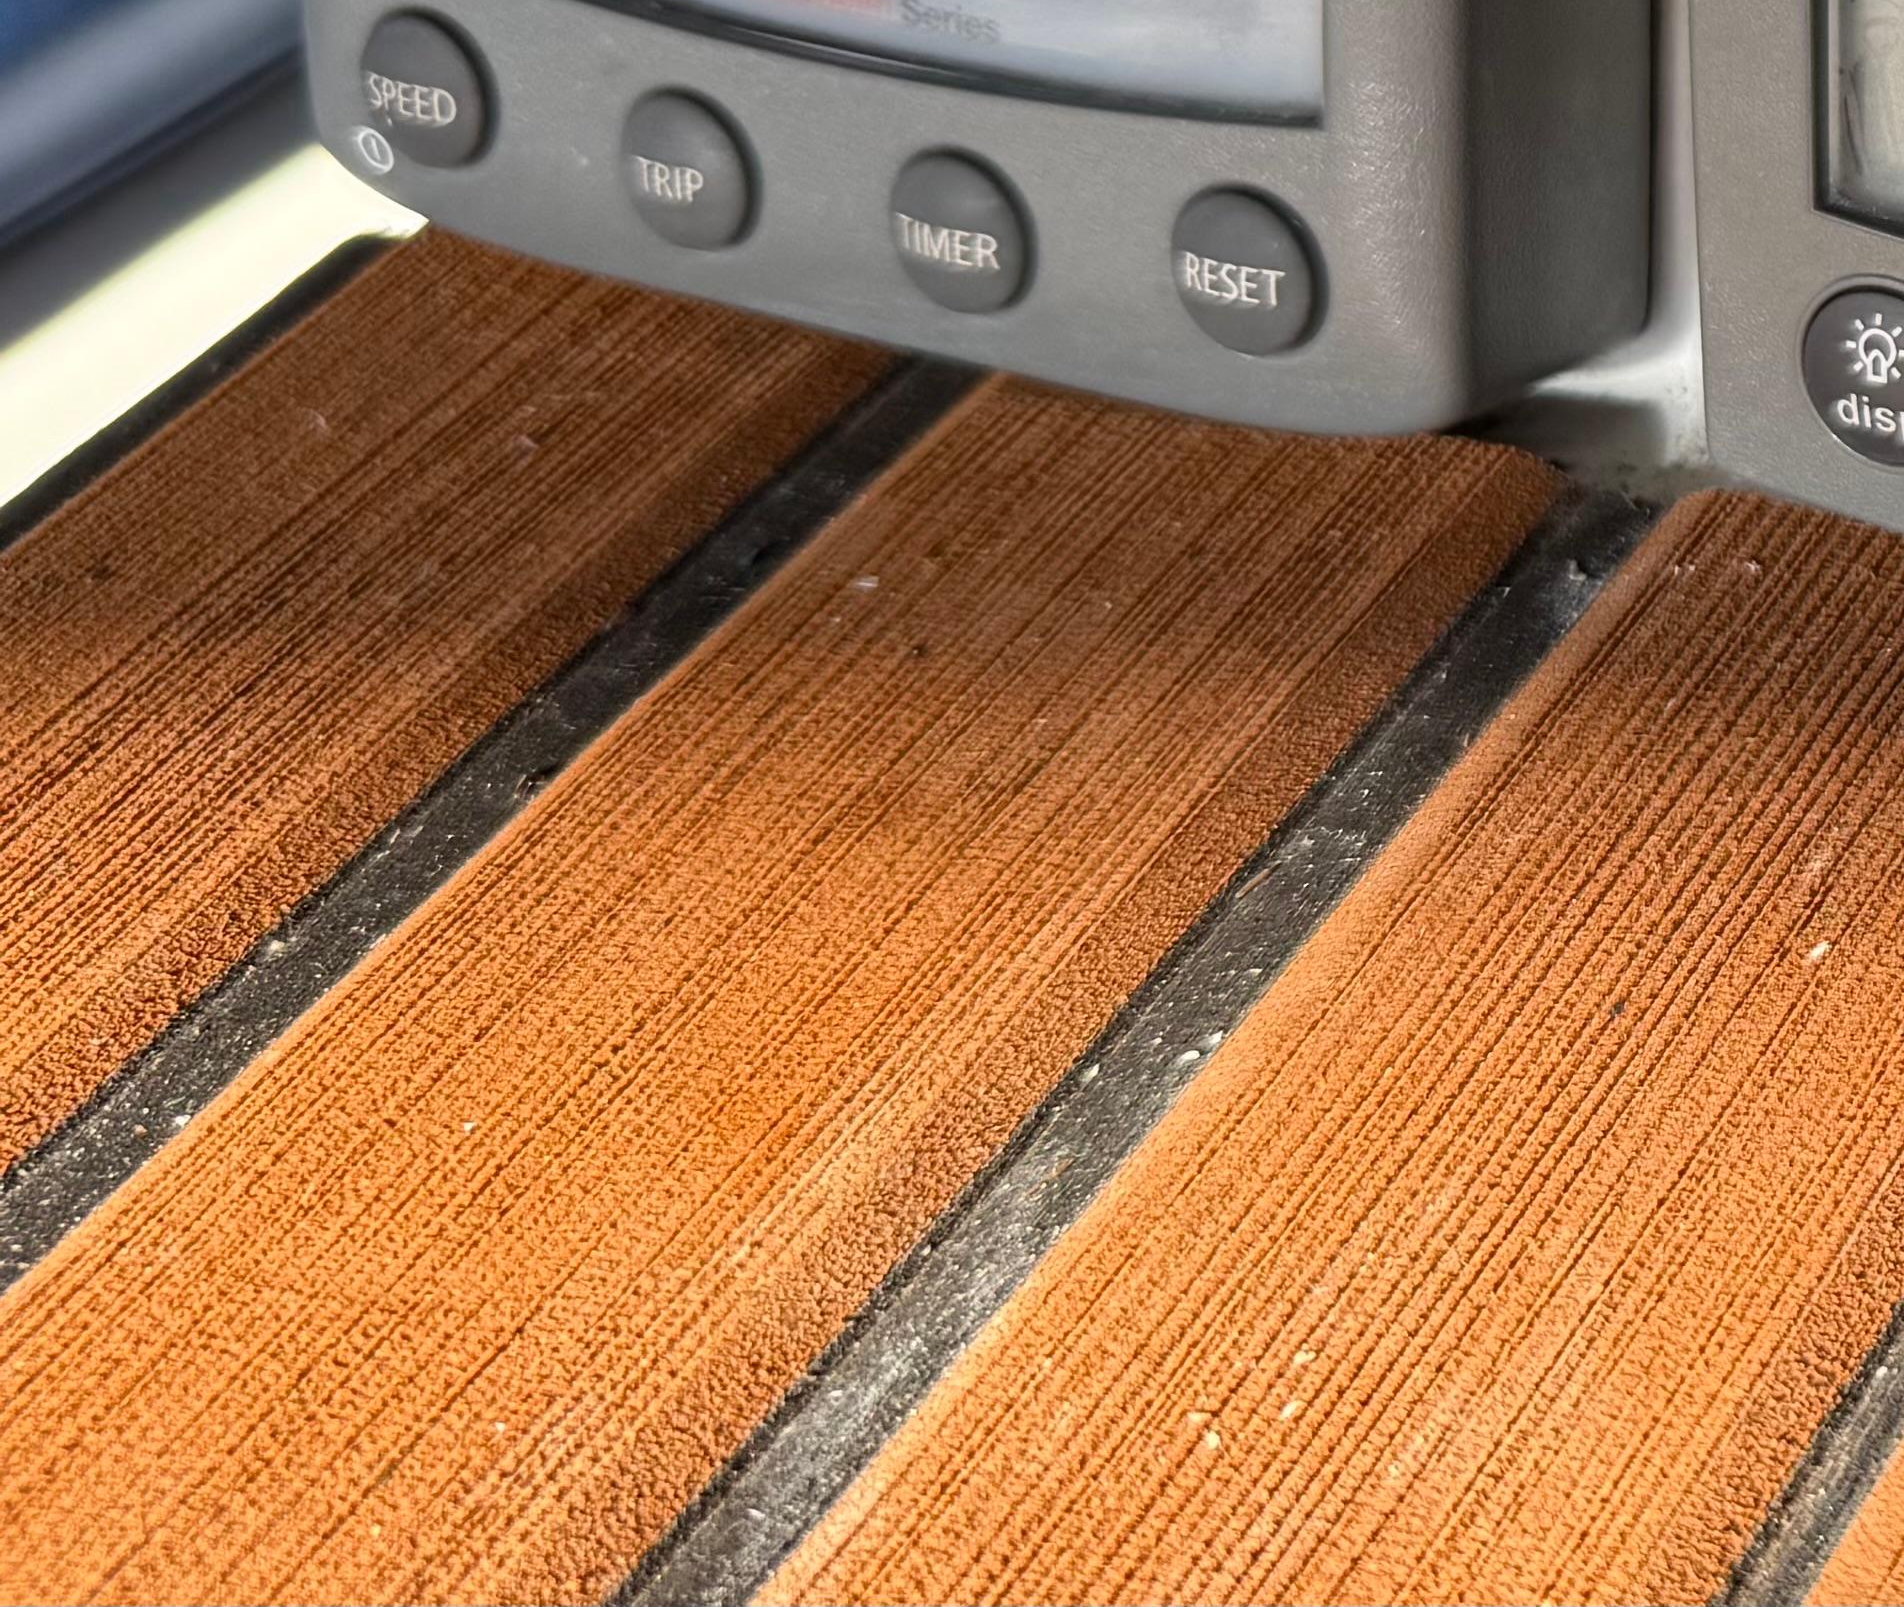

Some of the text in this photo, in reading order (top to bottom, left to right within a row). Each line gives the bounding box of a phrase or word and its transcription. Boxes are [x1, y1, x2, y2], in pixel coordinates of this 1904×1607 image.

[366, 72, 457, 127] SPEED
[632, 155, 704, 202] TRIP
[896, 212, 1000, 270] TIMER
[1183, 251, 1286, 308] RESET
